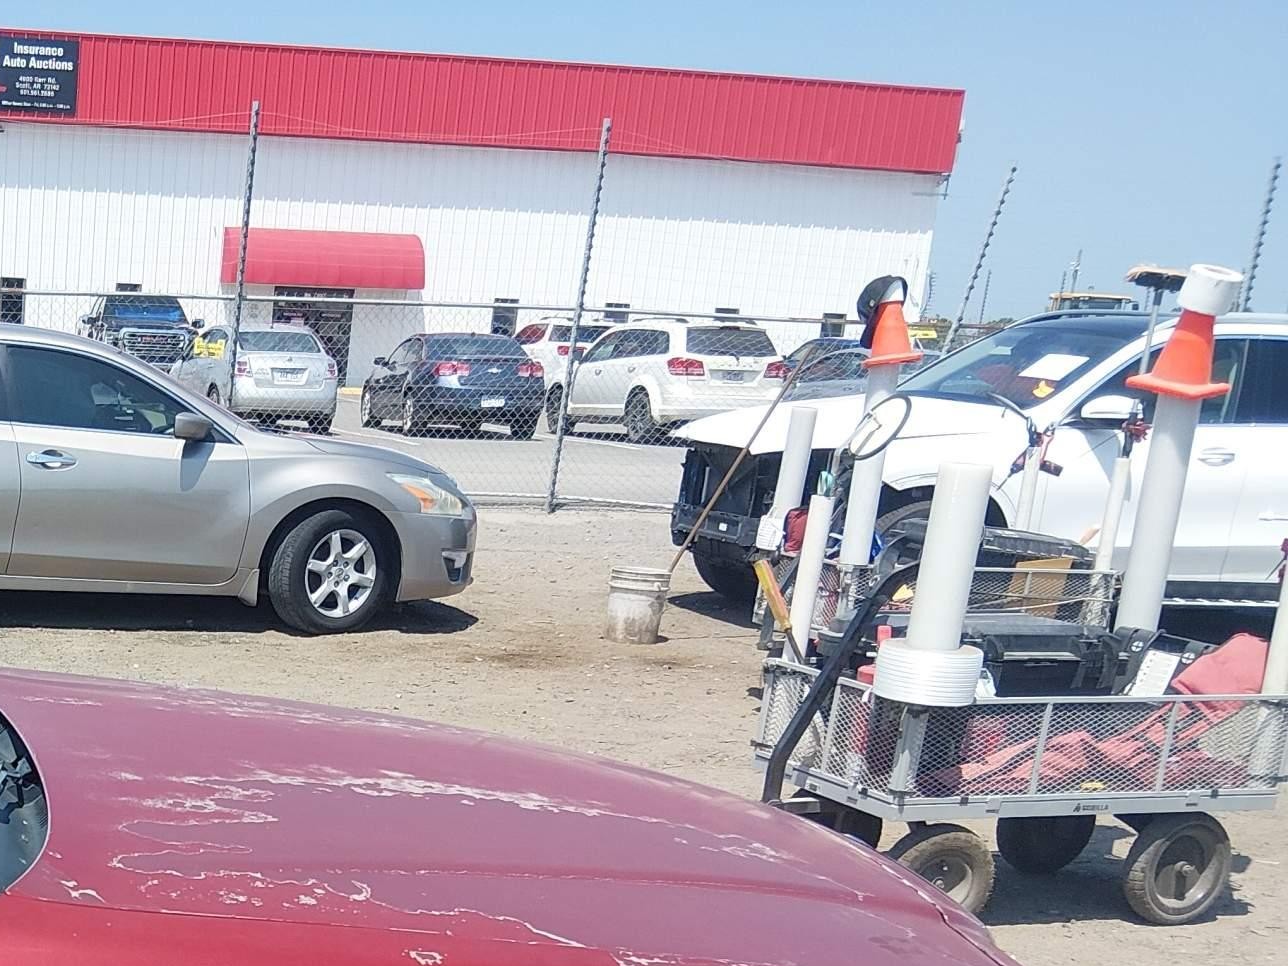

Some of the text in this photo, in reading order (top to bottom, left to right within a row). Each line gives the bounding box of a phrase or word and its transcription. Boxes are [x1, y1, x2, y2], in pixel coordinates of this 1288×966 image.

[14, 42, 64, 56] Insurance
[3, 55, 73, 70] Auto Auctions
